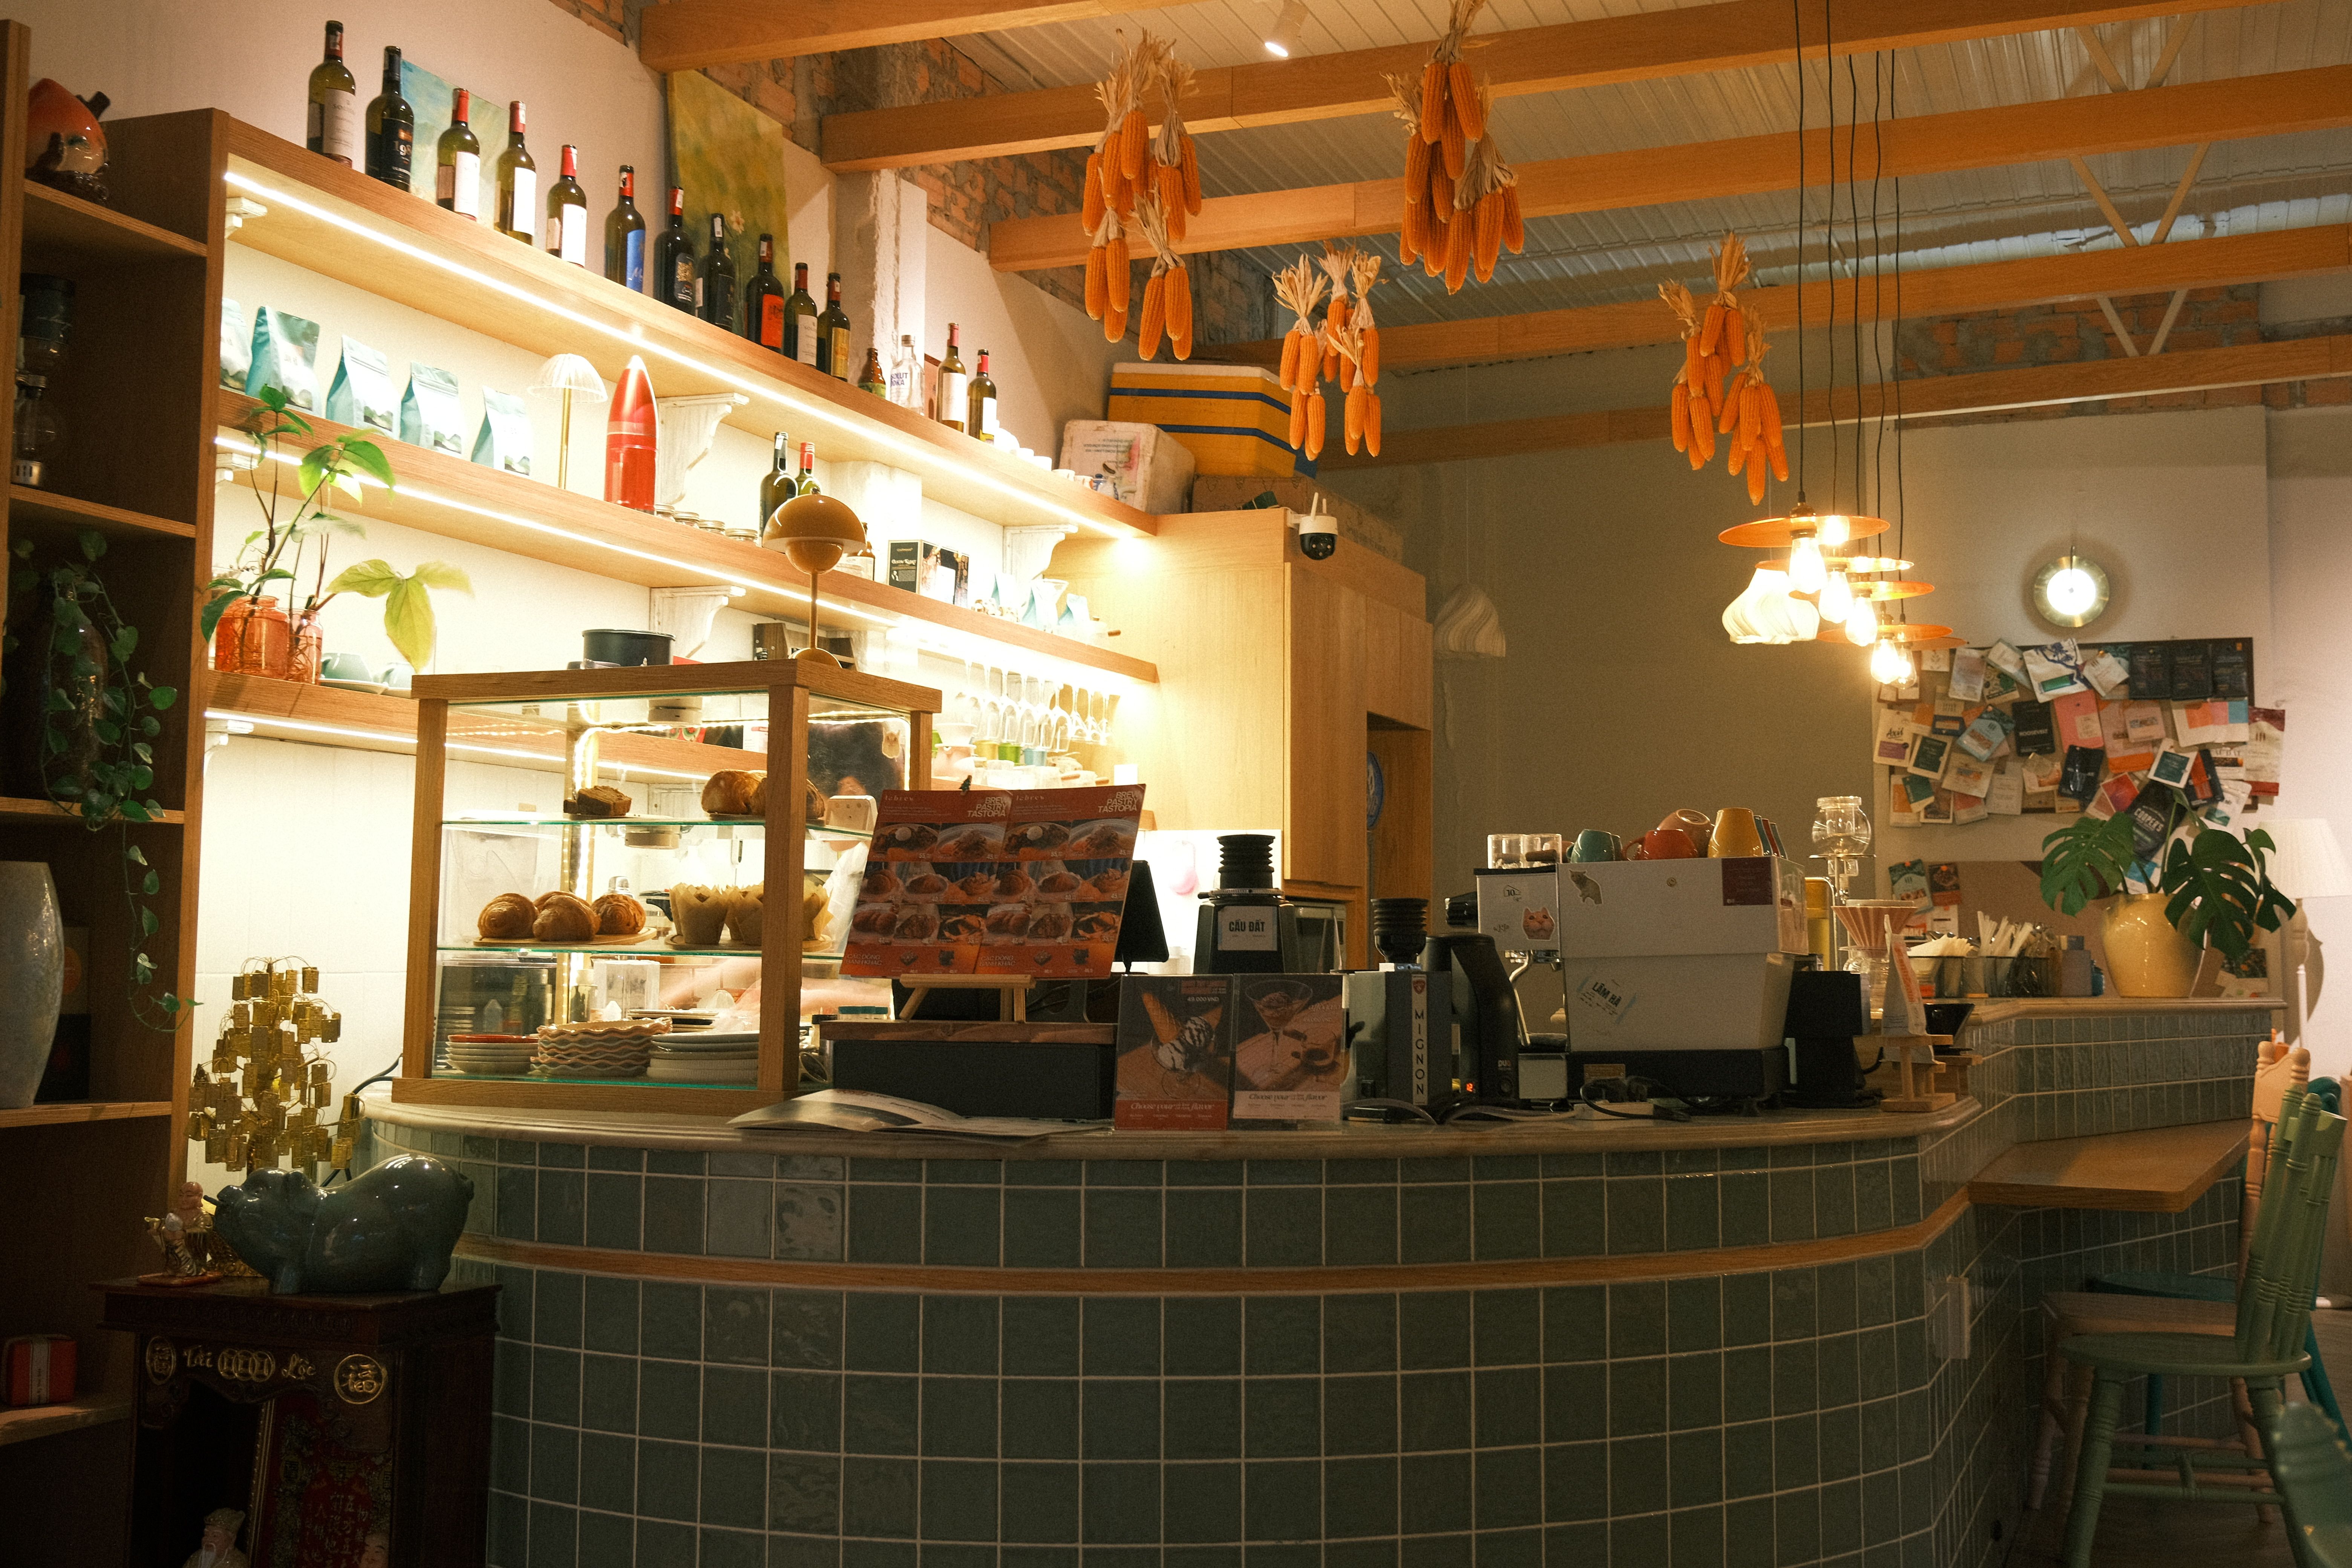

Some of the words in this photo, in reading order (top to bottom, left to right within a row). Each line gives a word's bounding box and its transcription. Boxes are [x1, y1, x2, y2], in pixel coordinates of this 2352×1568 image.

[1098, 804, 1137, 813] TASTOPIA
[1592, 982, 1611, 999] LÂM
[1415, 1009, 1425, 1095] MIGNON
[340, 1363, 381, 1394] 福
